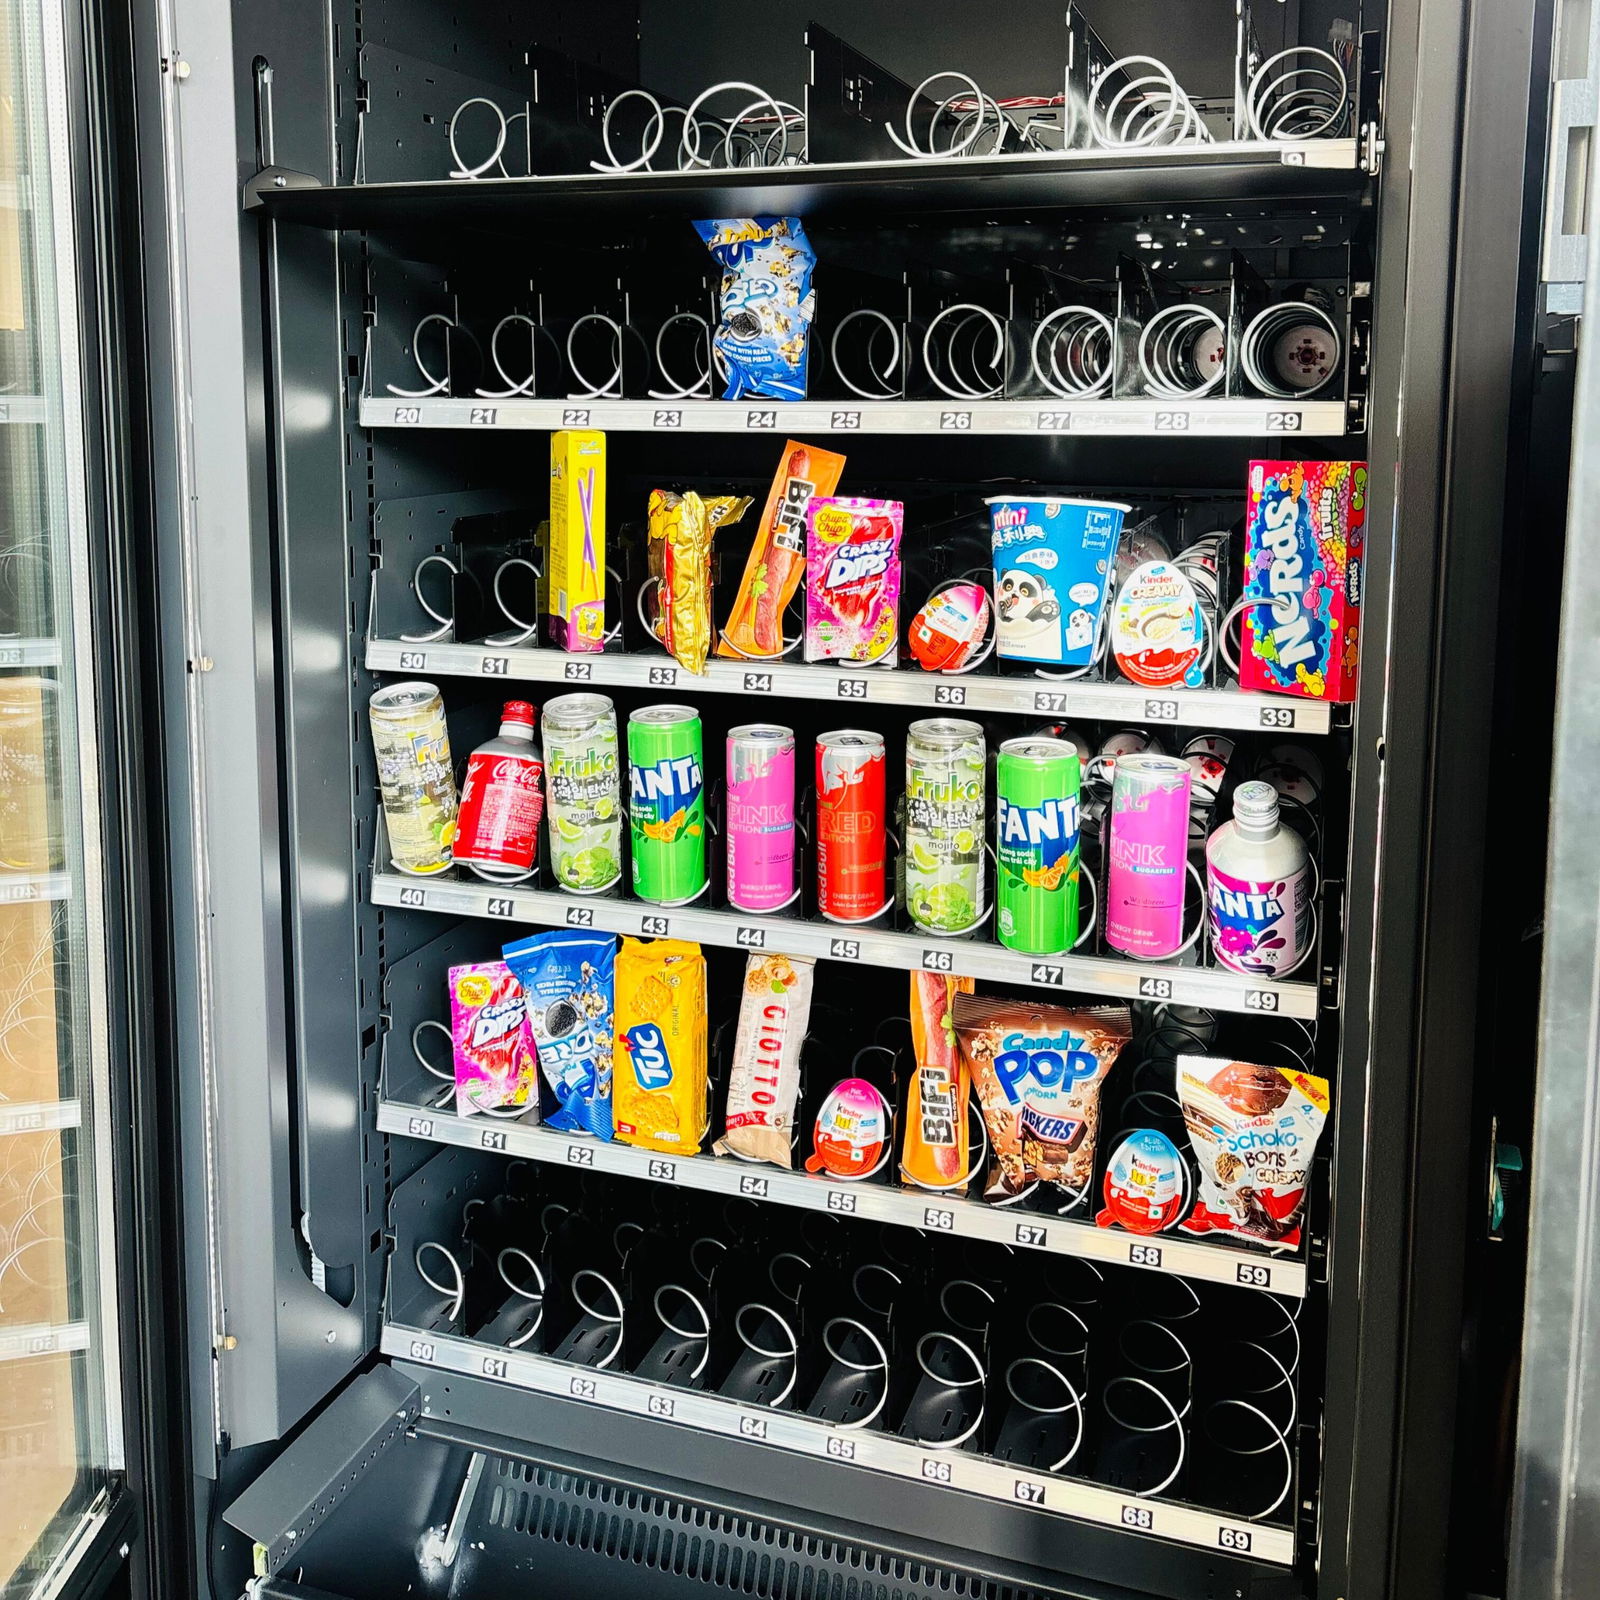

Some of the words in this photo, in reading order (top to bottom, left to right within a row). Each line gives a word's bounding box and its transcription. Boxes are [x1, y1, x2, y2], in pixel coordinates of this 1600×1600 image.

[752, 354, 771, 362] PIECES
[753, 347, 768, 355] REAL
[396, 409, 418, 423] 20
[471, 409, 494, 424] 21
[565, 411, 588, 425] 22
[656, 411, 680, 426] 23
[749, 412, 774, 427] 24
[833, 413, 858, 428] 25
[941, 413, 969, 429] 26
[1040, 413, 1068, 429] 27
[1157, 413, 1186, 429] 28
[1269, 413, 1298, 430] 29
[994, 507, 1028, 528] mini
[1319, 487, 1335, 541] fruits
[818, 523, 847, 535] Chups
[838, 540, 893, 558] CRAZY
[826, 551, 890, 588] DIPS
[1140, 575, 1173, 583] kinder
[1131, 585, 1183, 598] CREAMY
[402, 654, 424, 669] 30
[484, 659, 507, 673] 31
[567, 664, 590, 679] 32
[651, 669, 675, 684] 33
[745, 675, 771, 690] 34
[839, 680, 865, 697] 35
[937, 687, 964, 703] 36
[1037, 693, 1065, 711] 37
[1147, 701, 1176, 718] 38
[1263, 709, 1292, 726] 39
[551, 747, 615, 777] Fruko
[911, 766, 980, 802] Fruko
[571, 811, 600, 819] mojito
[729, 803, 787, 824] PINK
[821, 809, 876, 833] RED
[729, 822, 761, 834] EDITION
[727, 833, 735, 865] Bull
[929, 842, 959, 851] mojito
[1110, 835, 1165, 866] INK
[818, 842, 827, 874] Bull
[401, 889, 423, 905] 40
[818, 875, 827, 909] Red
[489, 900, 512, 915] 41
[1212, 887, 1282, 921] ANTA
[568, 909, 592, 925] 42
[643, 917, 667, 934] 43
[738, 929, 763, 945] 44
[1133, 929, 1154, 937] DRINK
[832, 941, 857, 957] 45
[924, 953, 952, 969] 46
[1033, 966, 1061, 982] 47
[1141, 980, 1170, 997] 48
[481, 997, 525, 1017] CRAZY
[1246, 992, 1276, 1010] 49
[472, 1005, 527, 1048] DIPS
[672, 1003, 680, 1036] ORIGINAL
[540, 1030, 593, 1064] ORE
[1002, 1030, 1085, 1050] Candy
[636, 1030, 666, 1084] TUC
[994, 1051, 1099, 1105] POP
[836, 1102, 862, 1118] kinder
[410, 1119, 431, 1134] 50
[483, 1133, 505, 1148] 51
[1140, 1143, 1165, 1151] EDITION
[569, 1148, 592, 1163] 52
[1131, 1153, 1161, 1174] kinder
[1244, 1150, 1286, 1168] Bons
[650, 1162, 673, 1178] 53
[741, 1178, 766, 1194] 54
[829, 1194, 854, 1211] 55
[926, 1210, 951, 1227] 56
[1017, 1226, 1045, 1244] 57
[1132, 1247, 1158, 1265] 58
[1239, 1266, 1267, 1284] 59
[412, 1343, 432, 1359] 60
[484, 1358, 506, 1375] 61
[571, 1379, 594, 1396] 62
[650, 1397, 673, 1414] 63
[741, 1418, 765, 1437] 64
[829, 1438, 853, 1456] 65
[924, 1462, 950, 1480] 66
[1017, 1483, 1043, 1501] 67
[1123, 1507, 1150, 1525] 68
[1221, 1529, 1249, 1549] 69
